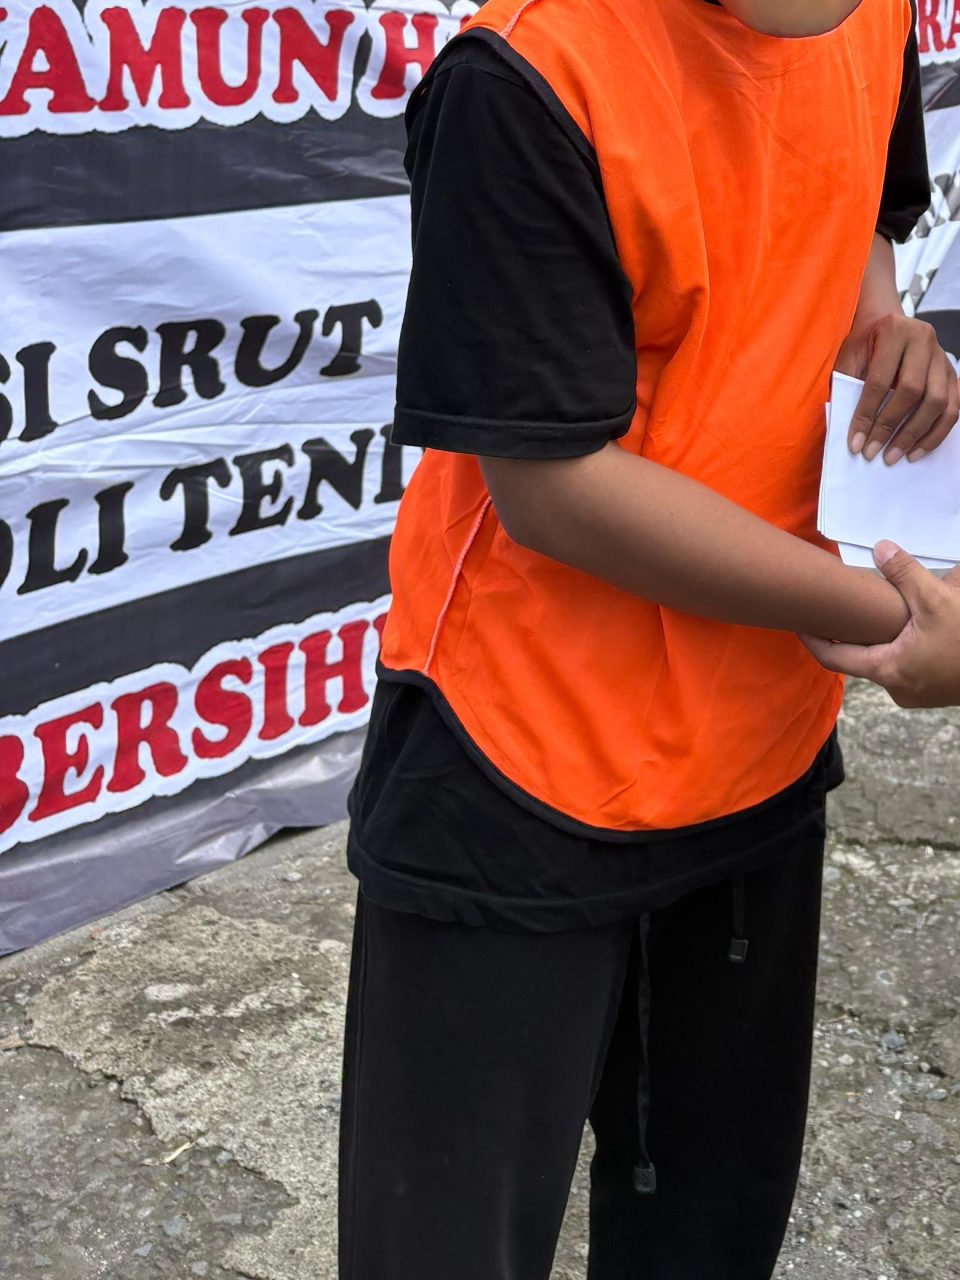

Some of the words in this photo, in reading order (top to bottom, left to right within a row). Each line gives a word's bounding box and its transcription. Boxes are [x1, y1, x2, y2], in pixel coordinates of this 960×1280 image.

[0, 5, 355, 115] AMUN
[88, 298, 383, 420] SRUT
[0, 480, 134, 596] LI
